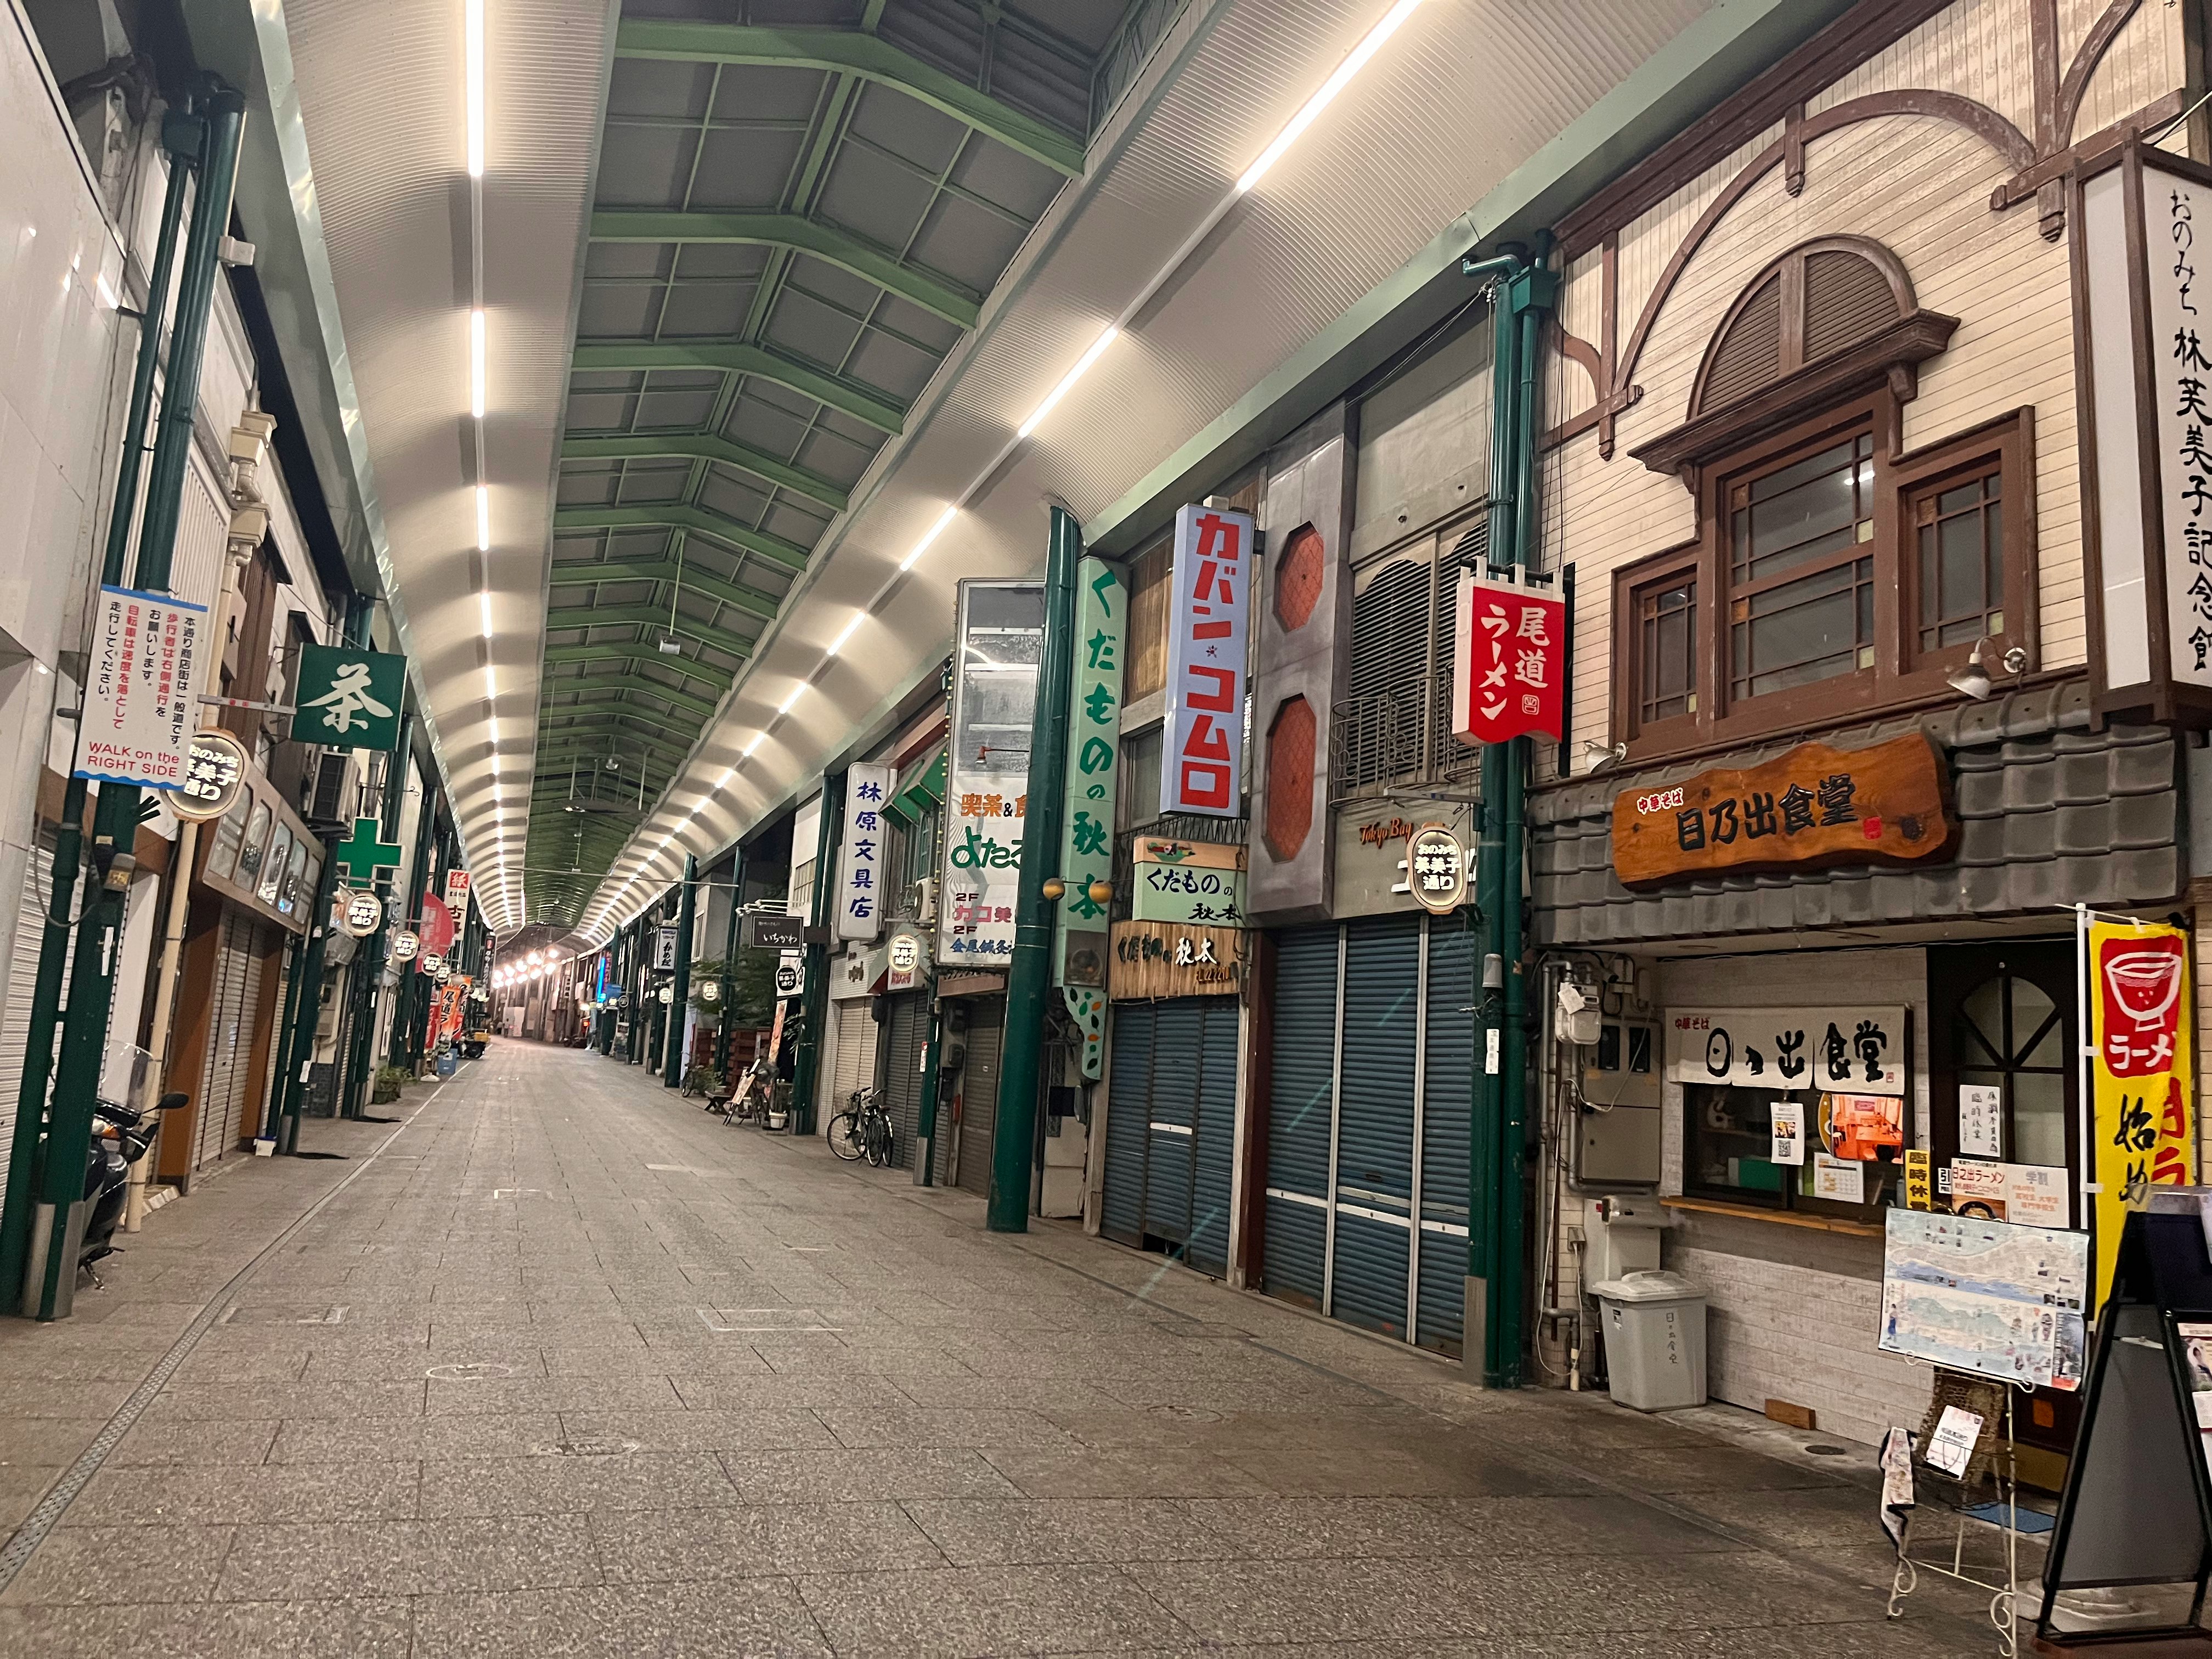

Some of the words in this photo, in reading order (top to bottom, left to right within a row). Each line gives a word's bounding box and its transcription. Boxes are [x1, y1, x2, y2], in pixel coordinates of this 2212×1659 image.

[1192, 514, 1239, 640] カバン
[1515, 606, 1549, 689] 尾道
[1479, 603, 1510, 721] ラーメン
[297, 662, 393, 733] 茶
[1068, 569, 1117, 919] くだものの秋本
[1180, 664, 1235, 809] コムロ
[88, 755, 136, 771] RIGHT
[142, 764, 178, 777] SIDE
[89, 741, 132, 757] WALK
[135, 751, 153, 760] on
[158, 752, 179, 764] the
[1637, 787, 1683, 815] 中華そば
[1675, 773, 1859, 851] 日乃出食堂
[1359, 822, 1389, 849] Tokyo
[1390, 817, 1414, 843] Bay
[849, 782, 882, 918] 林原文具店
[1418, 844, 1457, 855] おのみち
[1147, 868, 1233, 896] くだものの
[1423, 874, 1454, 890] 通り
[956, 893, 979, 901] 2F
[1188, 903, 1242, 921] 秋本
[764, 933, 798, 944] いちかわ
[953, 926, 977, 934] 2F
[1675, 1017, 1710, 1030] 中華そば
[2109, 1032, 2176, 1069] ラーメ
